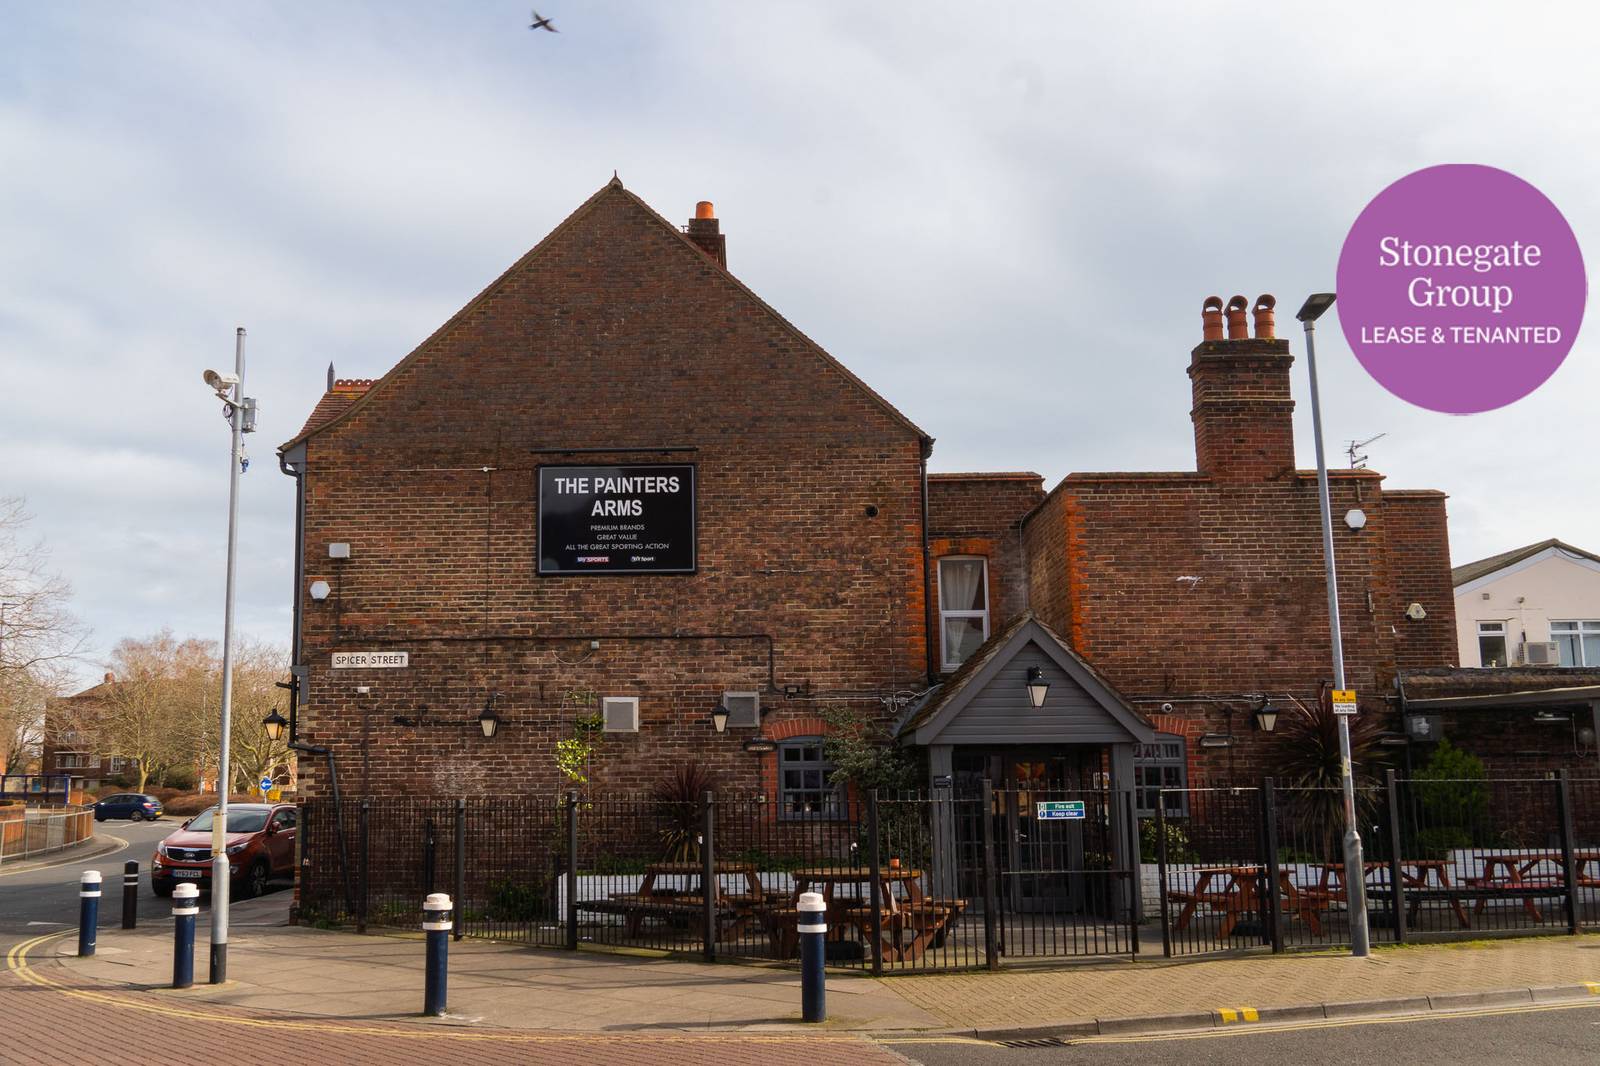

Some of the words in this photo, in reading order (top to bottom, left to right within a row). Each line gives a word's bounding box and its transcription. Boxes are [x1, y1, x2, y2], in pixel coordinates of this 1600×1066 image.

[554, 477, 589, 494] THE
[594, 476, 680, 494] PAINTERS
[591, 499, 643, 517] ARMS
[335, 656, 367, 664] SPICER
[370, 655, 404, 664] STREET
